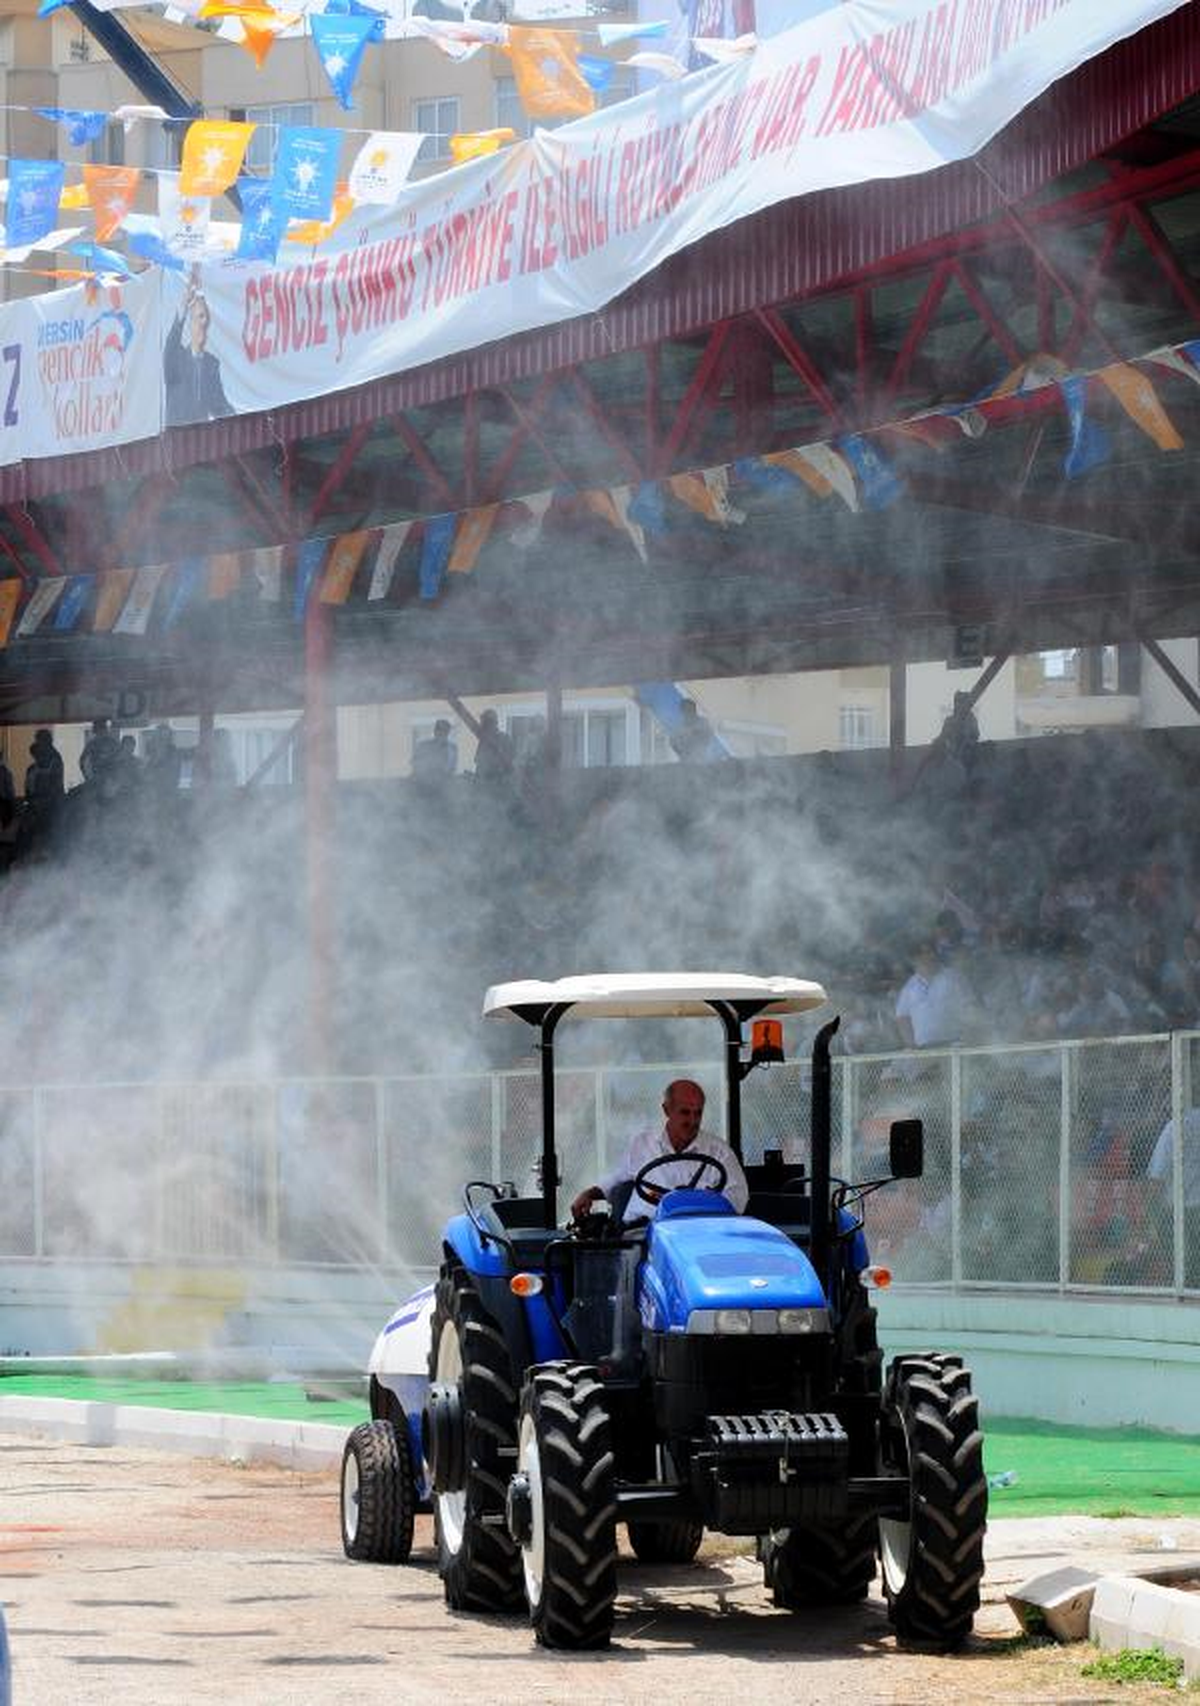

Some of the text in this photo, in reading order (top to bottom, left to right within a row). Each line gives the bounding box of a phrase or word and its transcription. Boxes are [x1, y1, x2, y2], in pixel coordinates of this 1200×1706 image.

[332, 208, 418, 364] ÇÜNKÜ
[421, 178, 518, 312] TÜRKİYE
[520, 158, 559, 276] İLE
